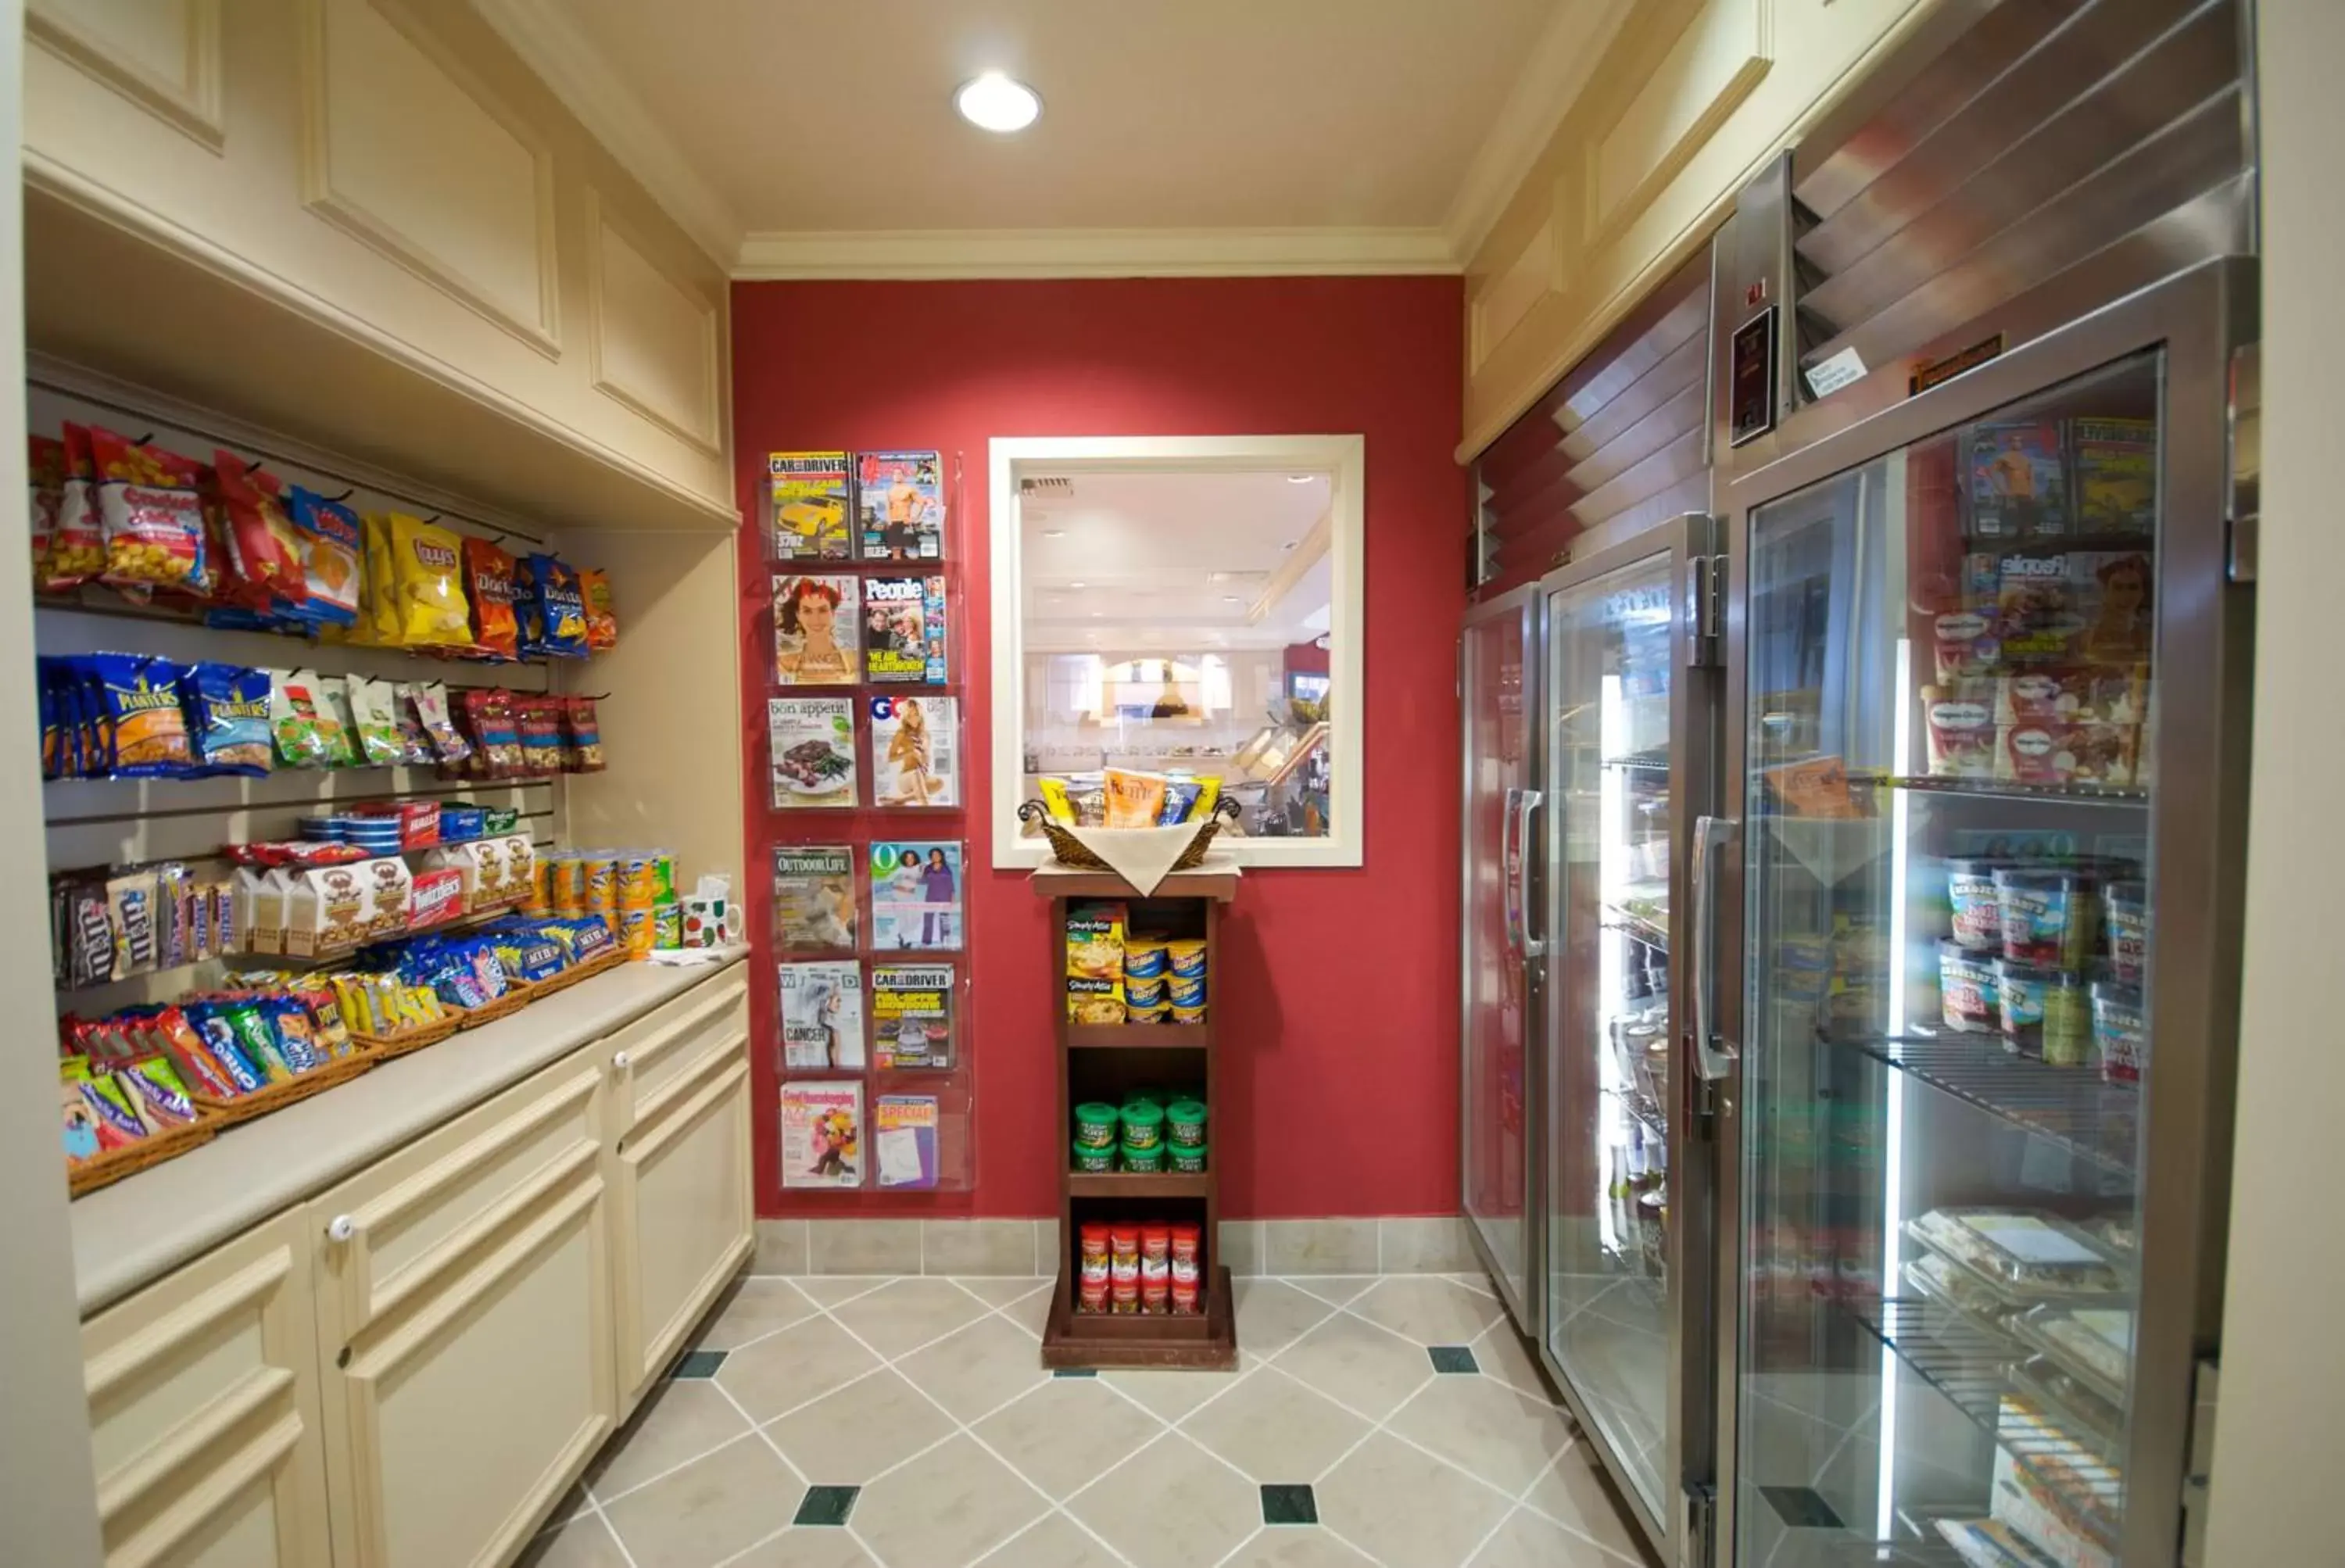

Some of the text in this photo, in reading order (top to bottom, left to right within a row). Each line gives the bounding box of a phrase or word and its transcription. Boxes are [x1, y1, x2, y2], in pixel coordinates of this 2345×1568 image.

[865, 578, 922, 600] People
[873, 843, 897, 872] O
[875, 974, 897, 986] CAR
[905, 974, 947, 986] DRIVER
[786, 1027, 826, 1042] CANCER
